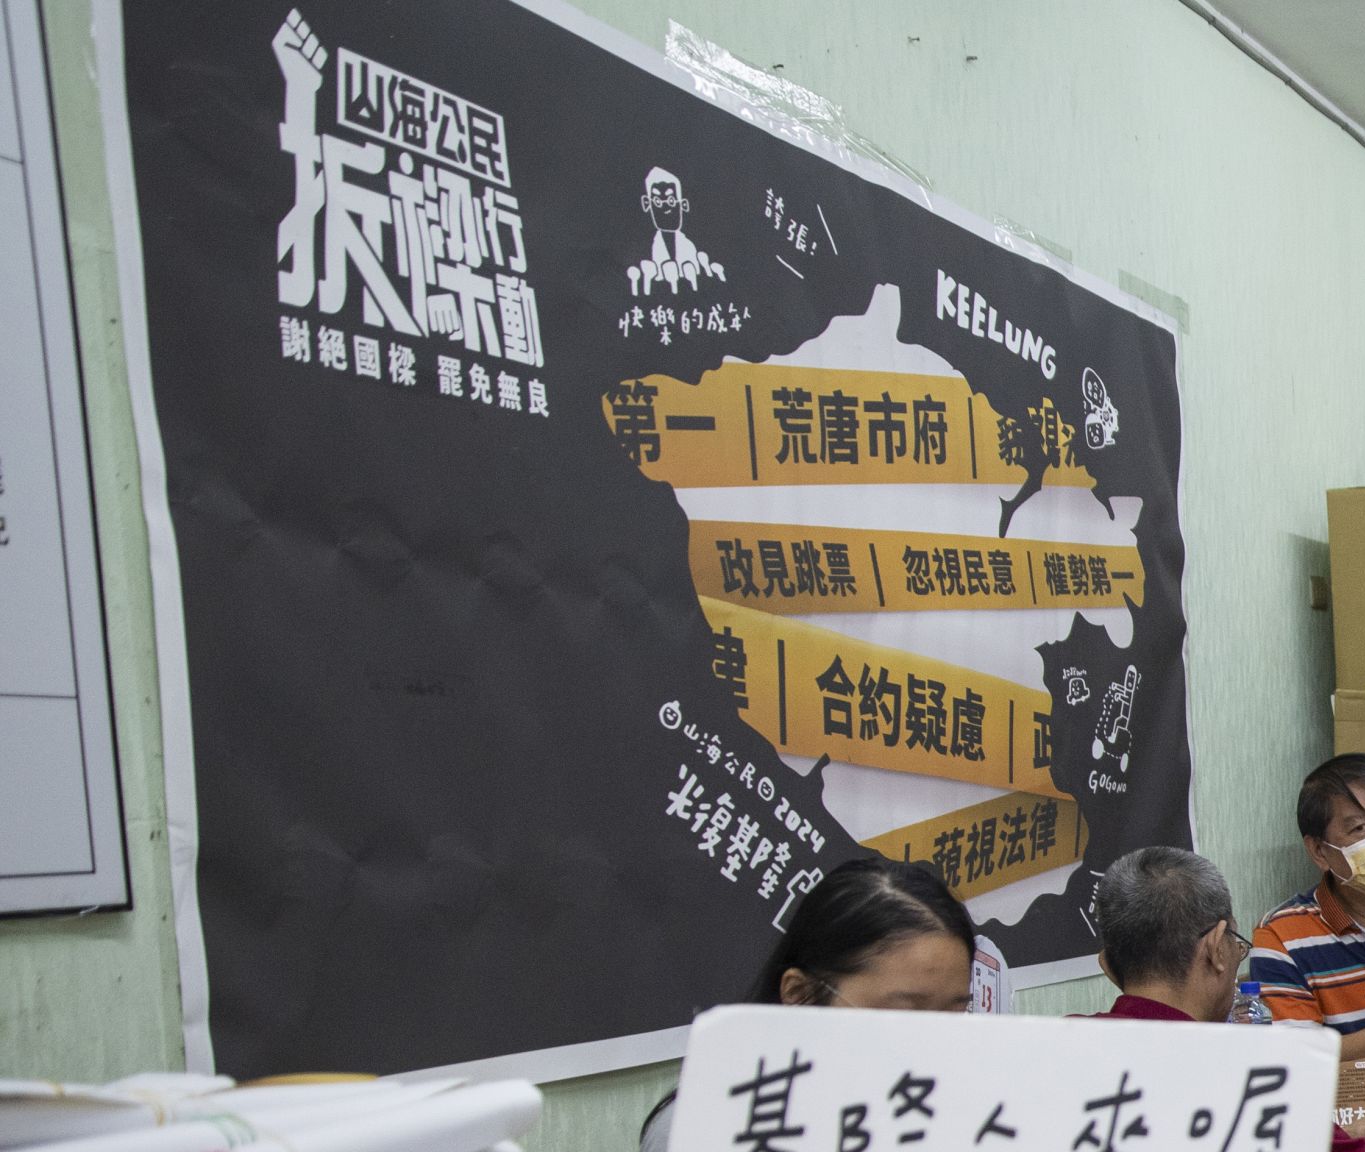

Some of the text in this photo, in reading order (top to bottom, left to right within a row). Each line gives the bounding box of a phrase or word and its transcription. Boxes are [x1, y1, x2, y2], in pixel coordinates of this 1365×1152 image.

[342, 58, 508, 182] 山海公民
[280, 315, 550, 418] 謝絕國樑 罷免無良
[618, 302, 751, 346] 快樂的成年人
[935, 269, 1057, 380] KEELUNG
[611, 381, 717, 468] 第一
[772, 387, 949, 467] 荒唐市府
[716, 536, 1134, 600] 政見跳票 忽視民意 權勢第一
[814, 654, 988, 762] 合約疑慮
[664, 763, 796, 900] 光復基隆
[681, 720, 827, 853] 山海公民 2024
[1088, 770, 1127, 795] GOGONO
